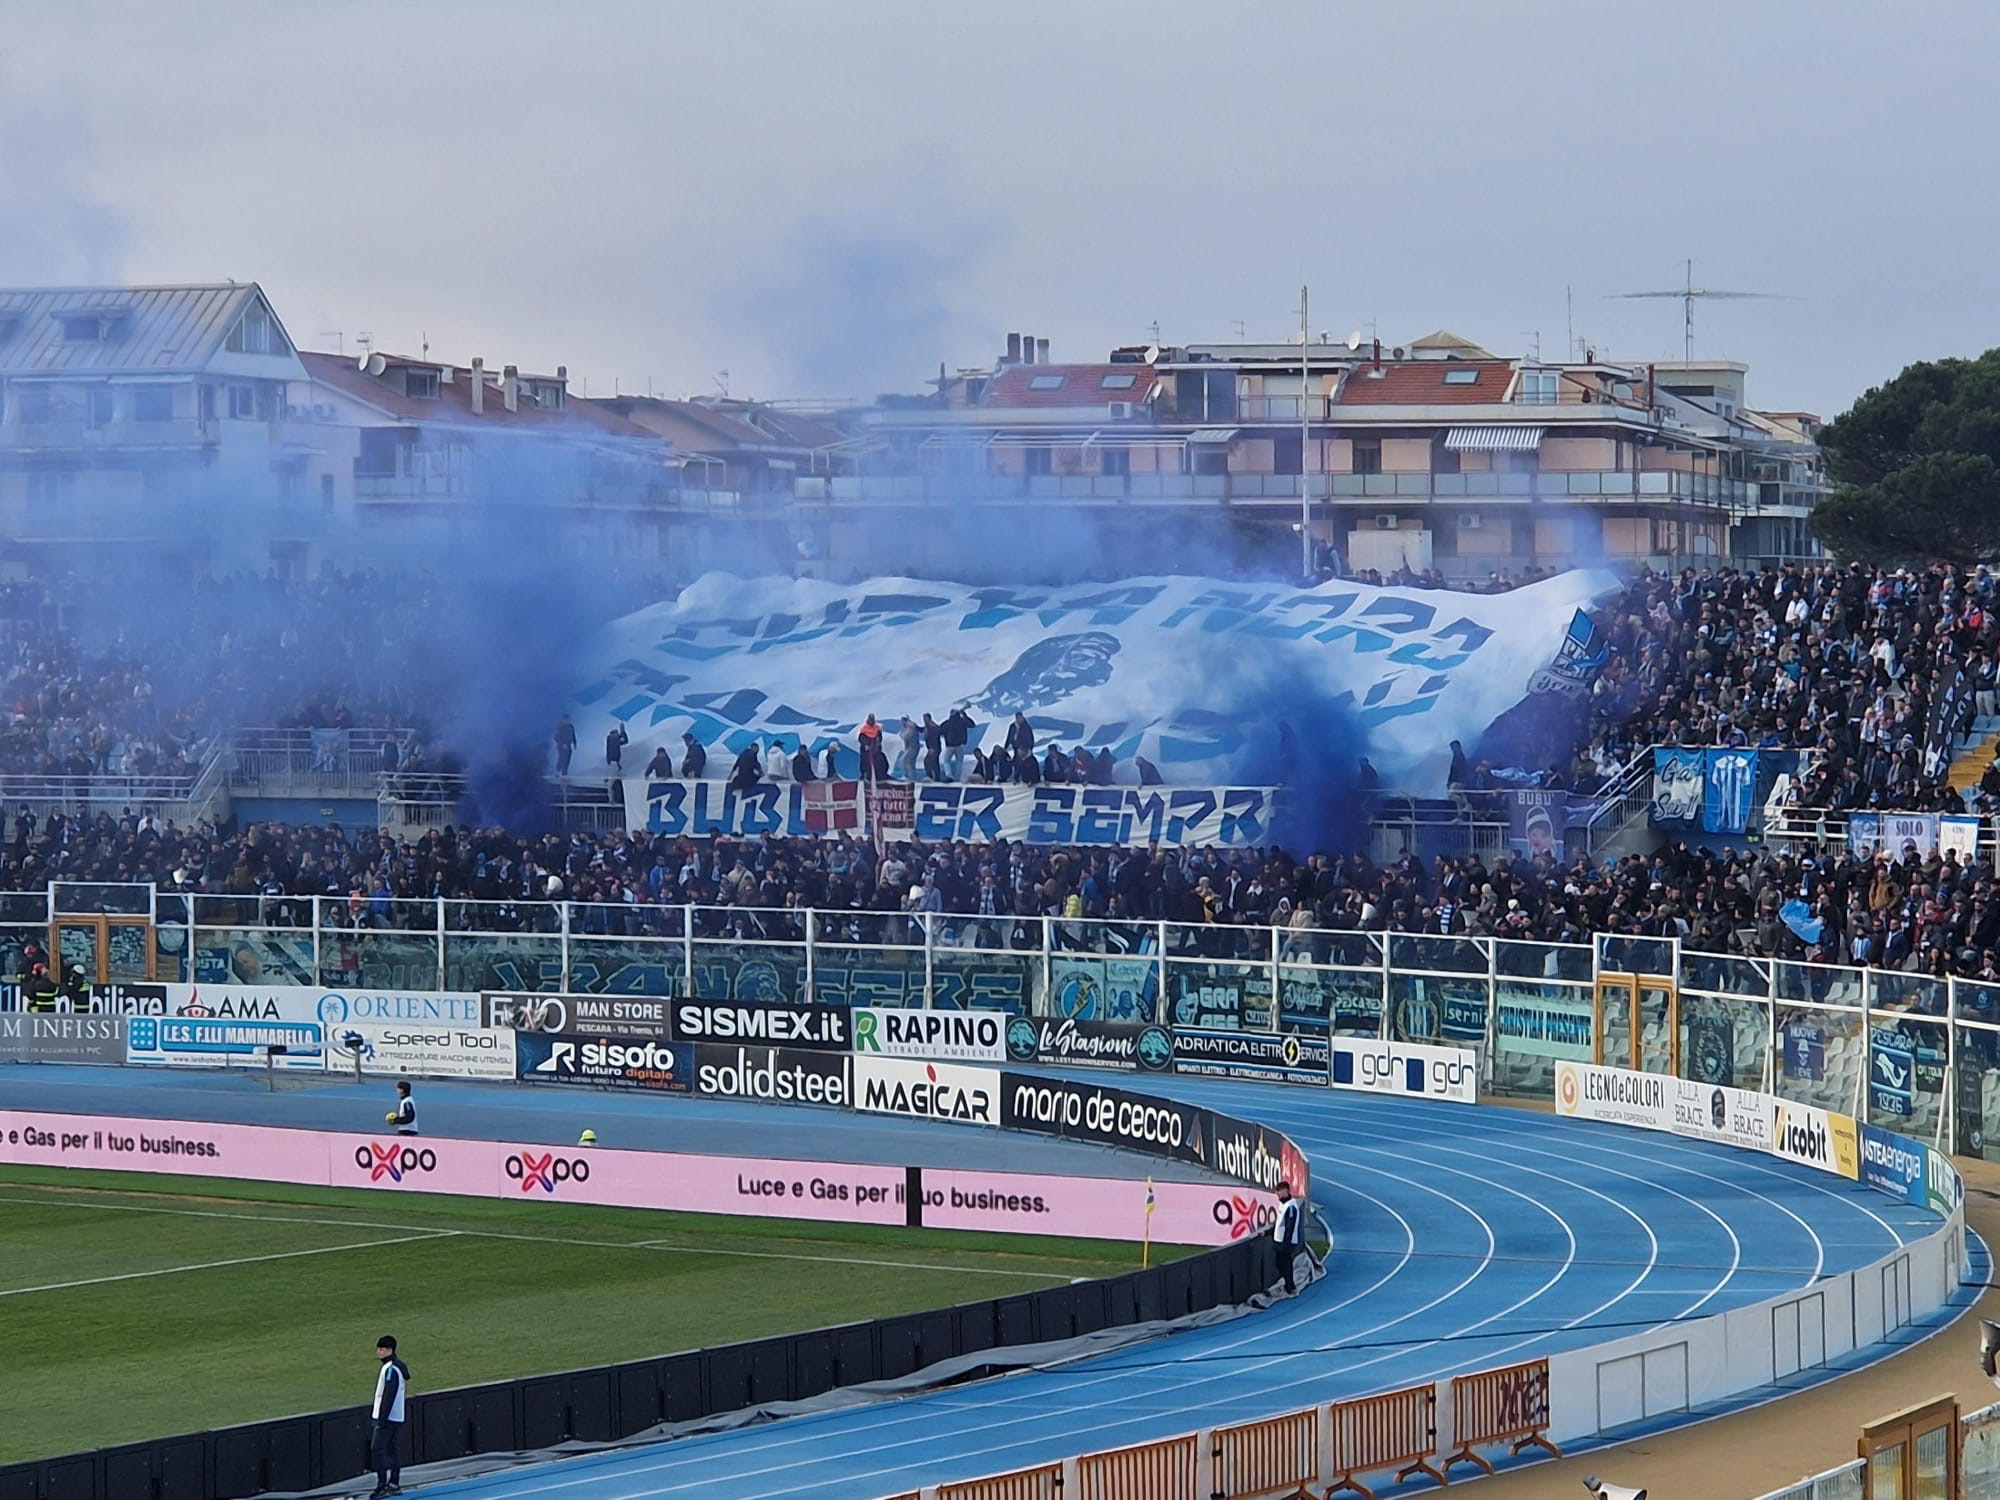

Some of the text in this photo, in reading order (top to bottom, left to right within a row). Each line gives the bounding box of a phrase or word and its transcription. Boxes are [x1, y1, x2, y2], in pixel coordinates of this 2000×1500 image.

[1895, 820, 1924, 836] SOLO
[353, 995, 478, 1021] ORIENTE
[576, 1001, 663, 1020] MAN STORE
[32, 1018, 121, 1040] INFISSI
[576, 1023, 612, 1033] PESCARA
[679, 1005, 845, 1043] SISMEX.it
[886, 1014, 999, 1048] RAPINO
[224, 1028, 314, 1047] MAMMARELLA
[379, 1031, 450, 1048] Speed
[454, 1032, 498, 1050] Tool
[1173, 1036, 1250, 1055] ADRIATICA
[1871, 1027, 1912, 1052] PESCARA
[379, 1052, 439, 1062] ATTREZZATURE
[580, 1039, 675, 1070] sisofo
[944, 1048, 999, 1059] AMBIENTE
[580, 1064, 674, 1080] futuro digitale
[699, 1047, 850, 1105] solidsteel
[1361, 1045, 1474, 1094] gdr gdr
[865, 1077, 991, 1122] MAGICAR
[1877, 1092, 1904, 1115] 1936
[1014, 1085, 1183, 1148] mario de cecco
[1673, 1103, 1705, 1127] BRACE
[1732, 1114, 1766, 1139] BRACE
[9, 1126, 221, 1158] e Gas per il tuo business.
[1787, 1112, 1828, 1164] icobit
[355, 1142, 437, 1183] axpo
[1217, 1133, 1251, 1181] notti
[505, 1152, 590, 1194] axpo
[737, 1174, 1051, 1214] Luce e Gas per il uo business.
